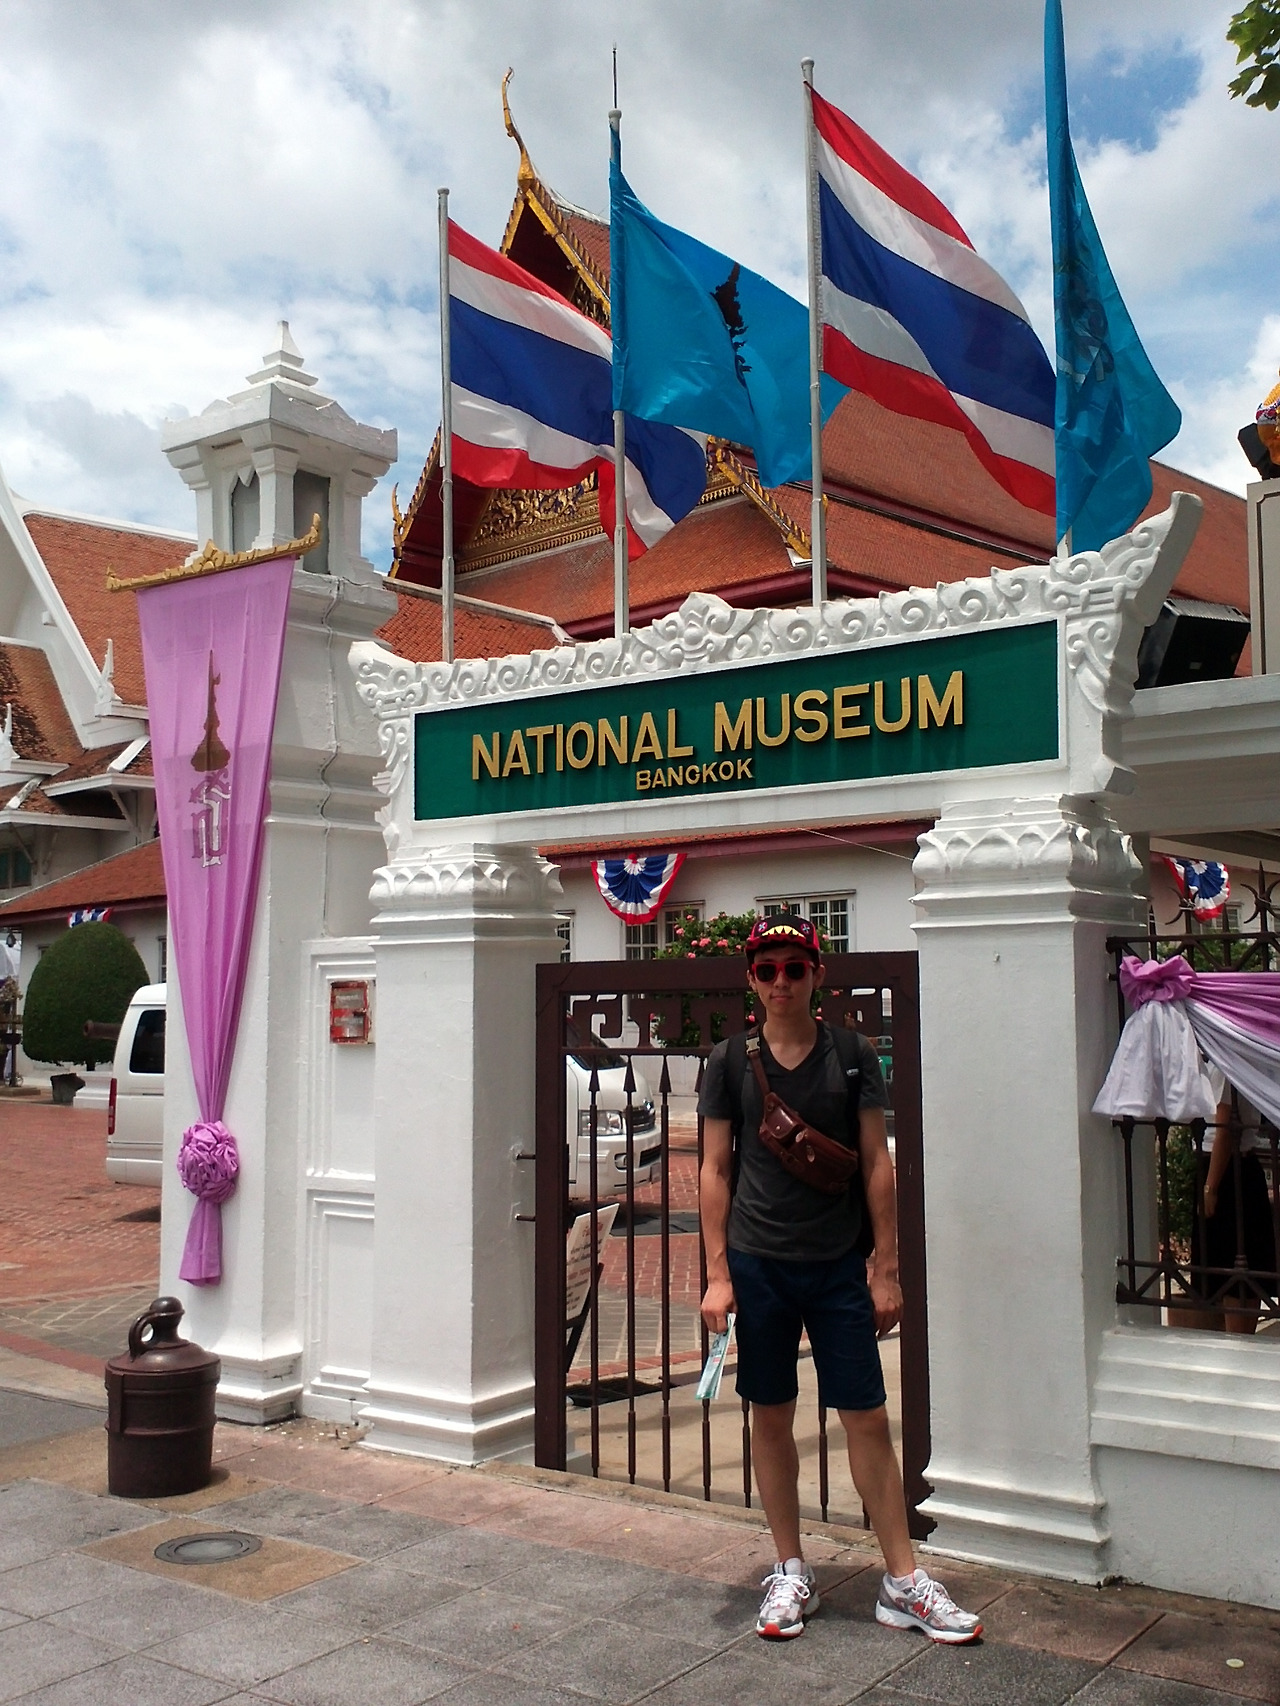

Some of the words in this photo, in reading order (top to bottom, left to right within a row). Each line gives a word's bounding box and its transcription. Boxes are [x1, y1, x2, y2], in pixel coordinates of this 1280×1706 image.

[471, 708, 694, 780] NATIONAL
[713, 670, 963, 754] MUSEUM
[635, 757, 753, 791] BANGKOK
